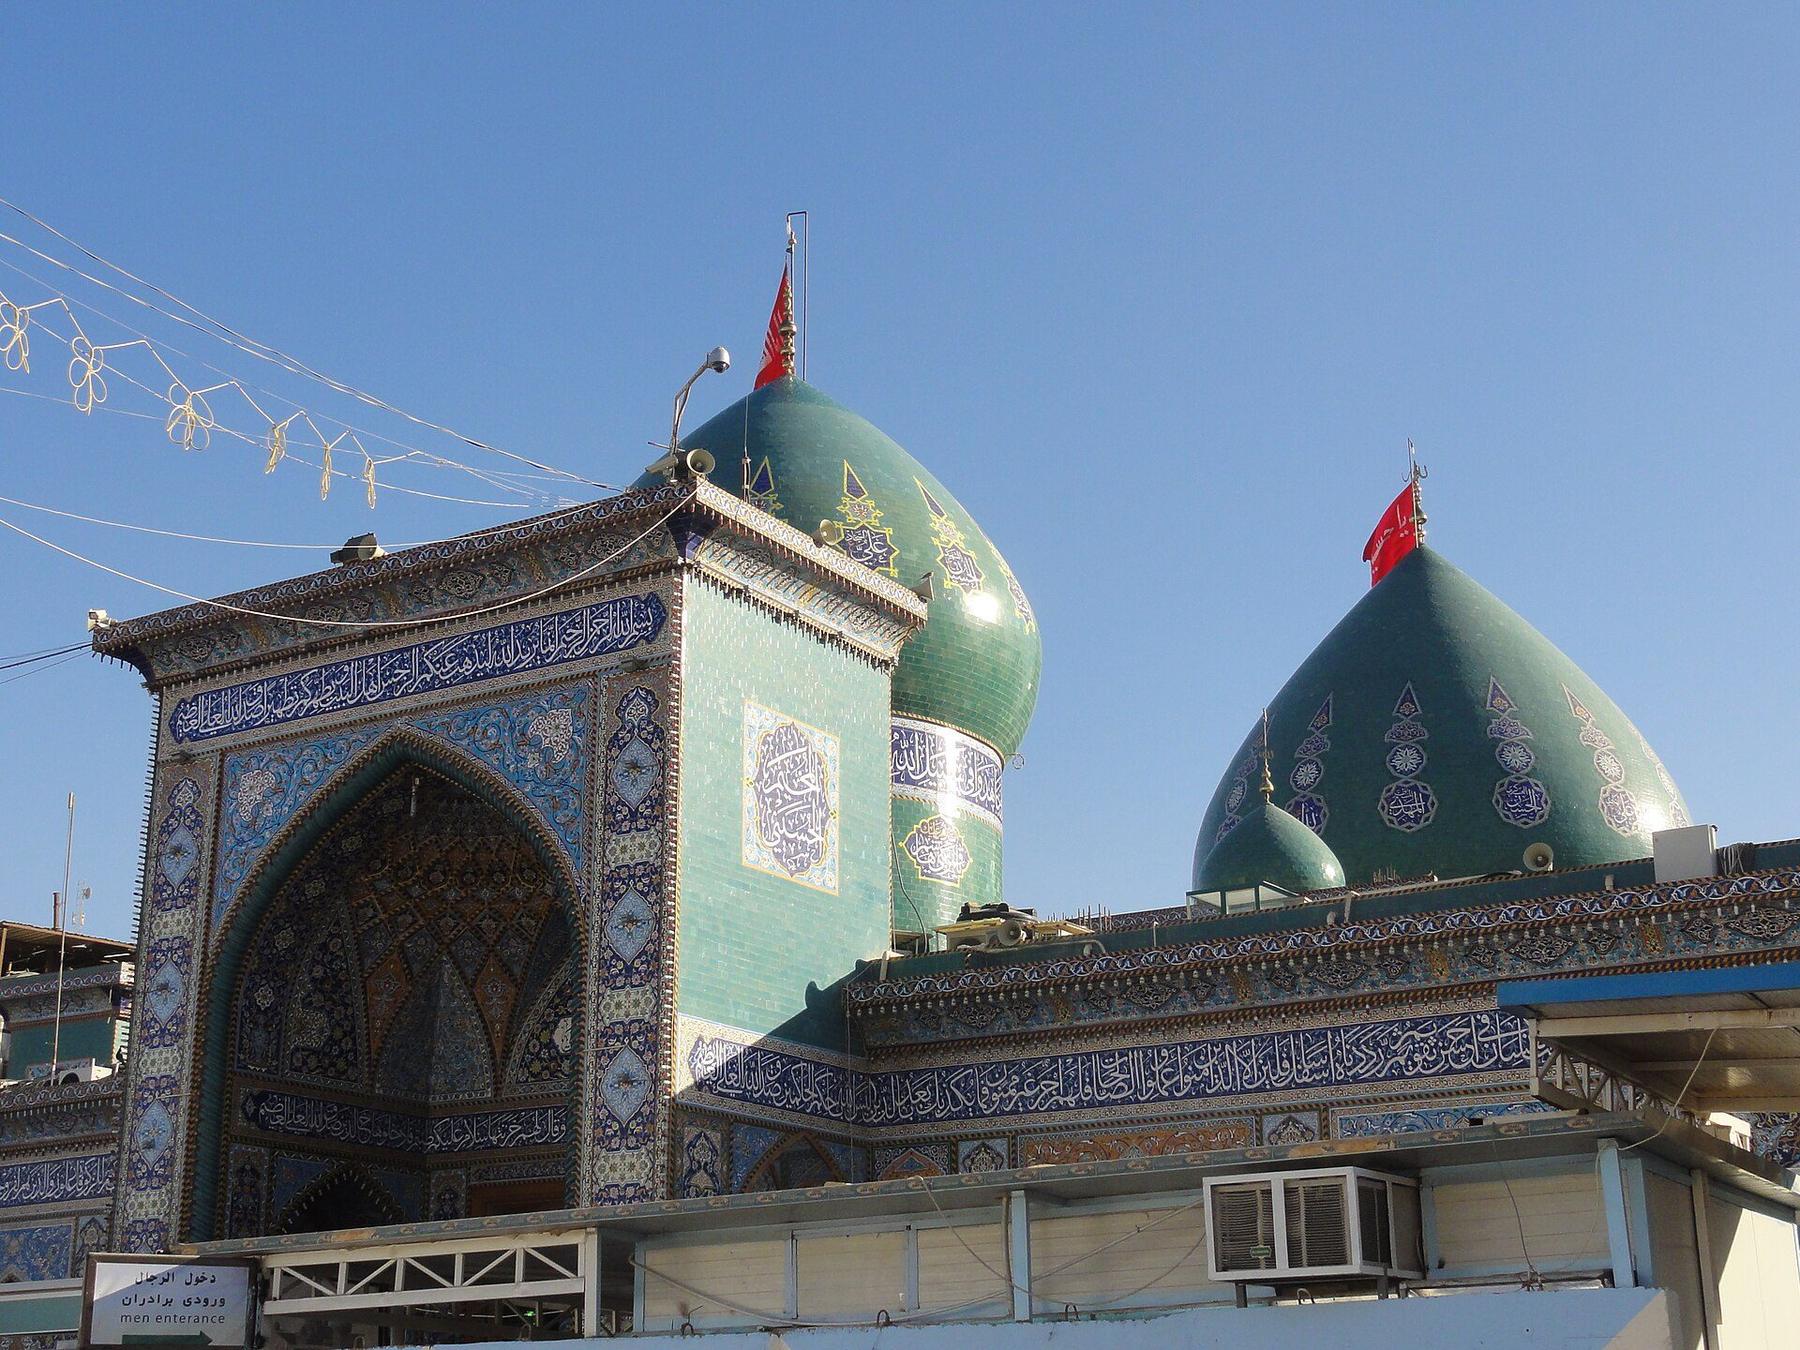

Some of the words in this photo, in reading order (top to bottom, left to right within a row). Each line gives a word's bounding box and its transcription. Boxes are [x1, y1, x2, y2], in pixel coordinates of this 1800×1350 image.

[135, 1271, 175, 1286] الرجال
[185, 1271, 216, 1286] دخول
[122, 1293, 174, 1307] برادران
[183, 1295, 226, 1307] ورودی
[121, 1314, 149, 1323] men
[156, 1313, 225, 1324] enterance
